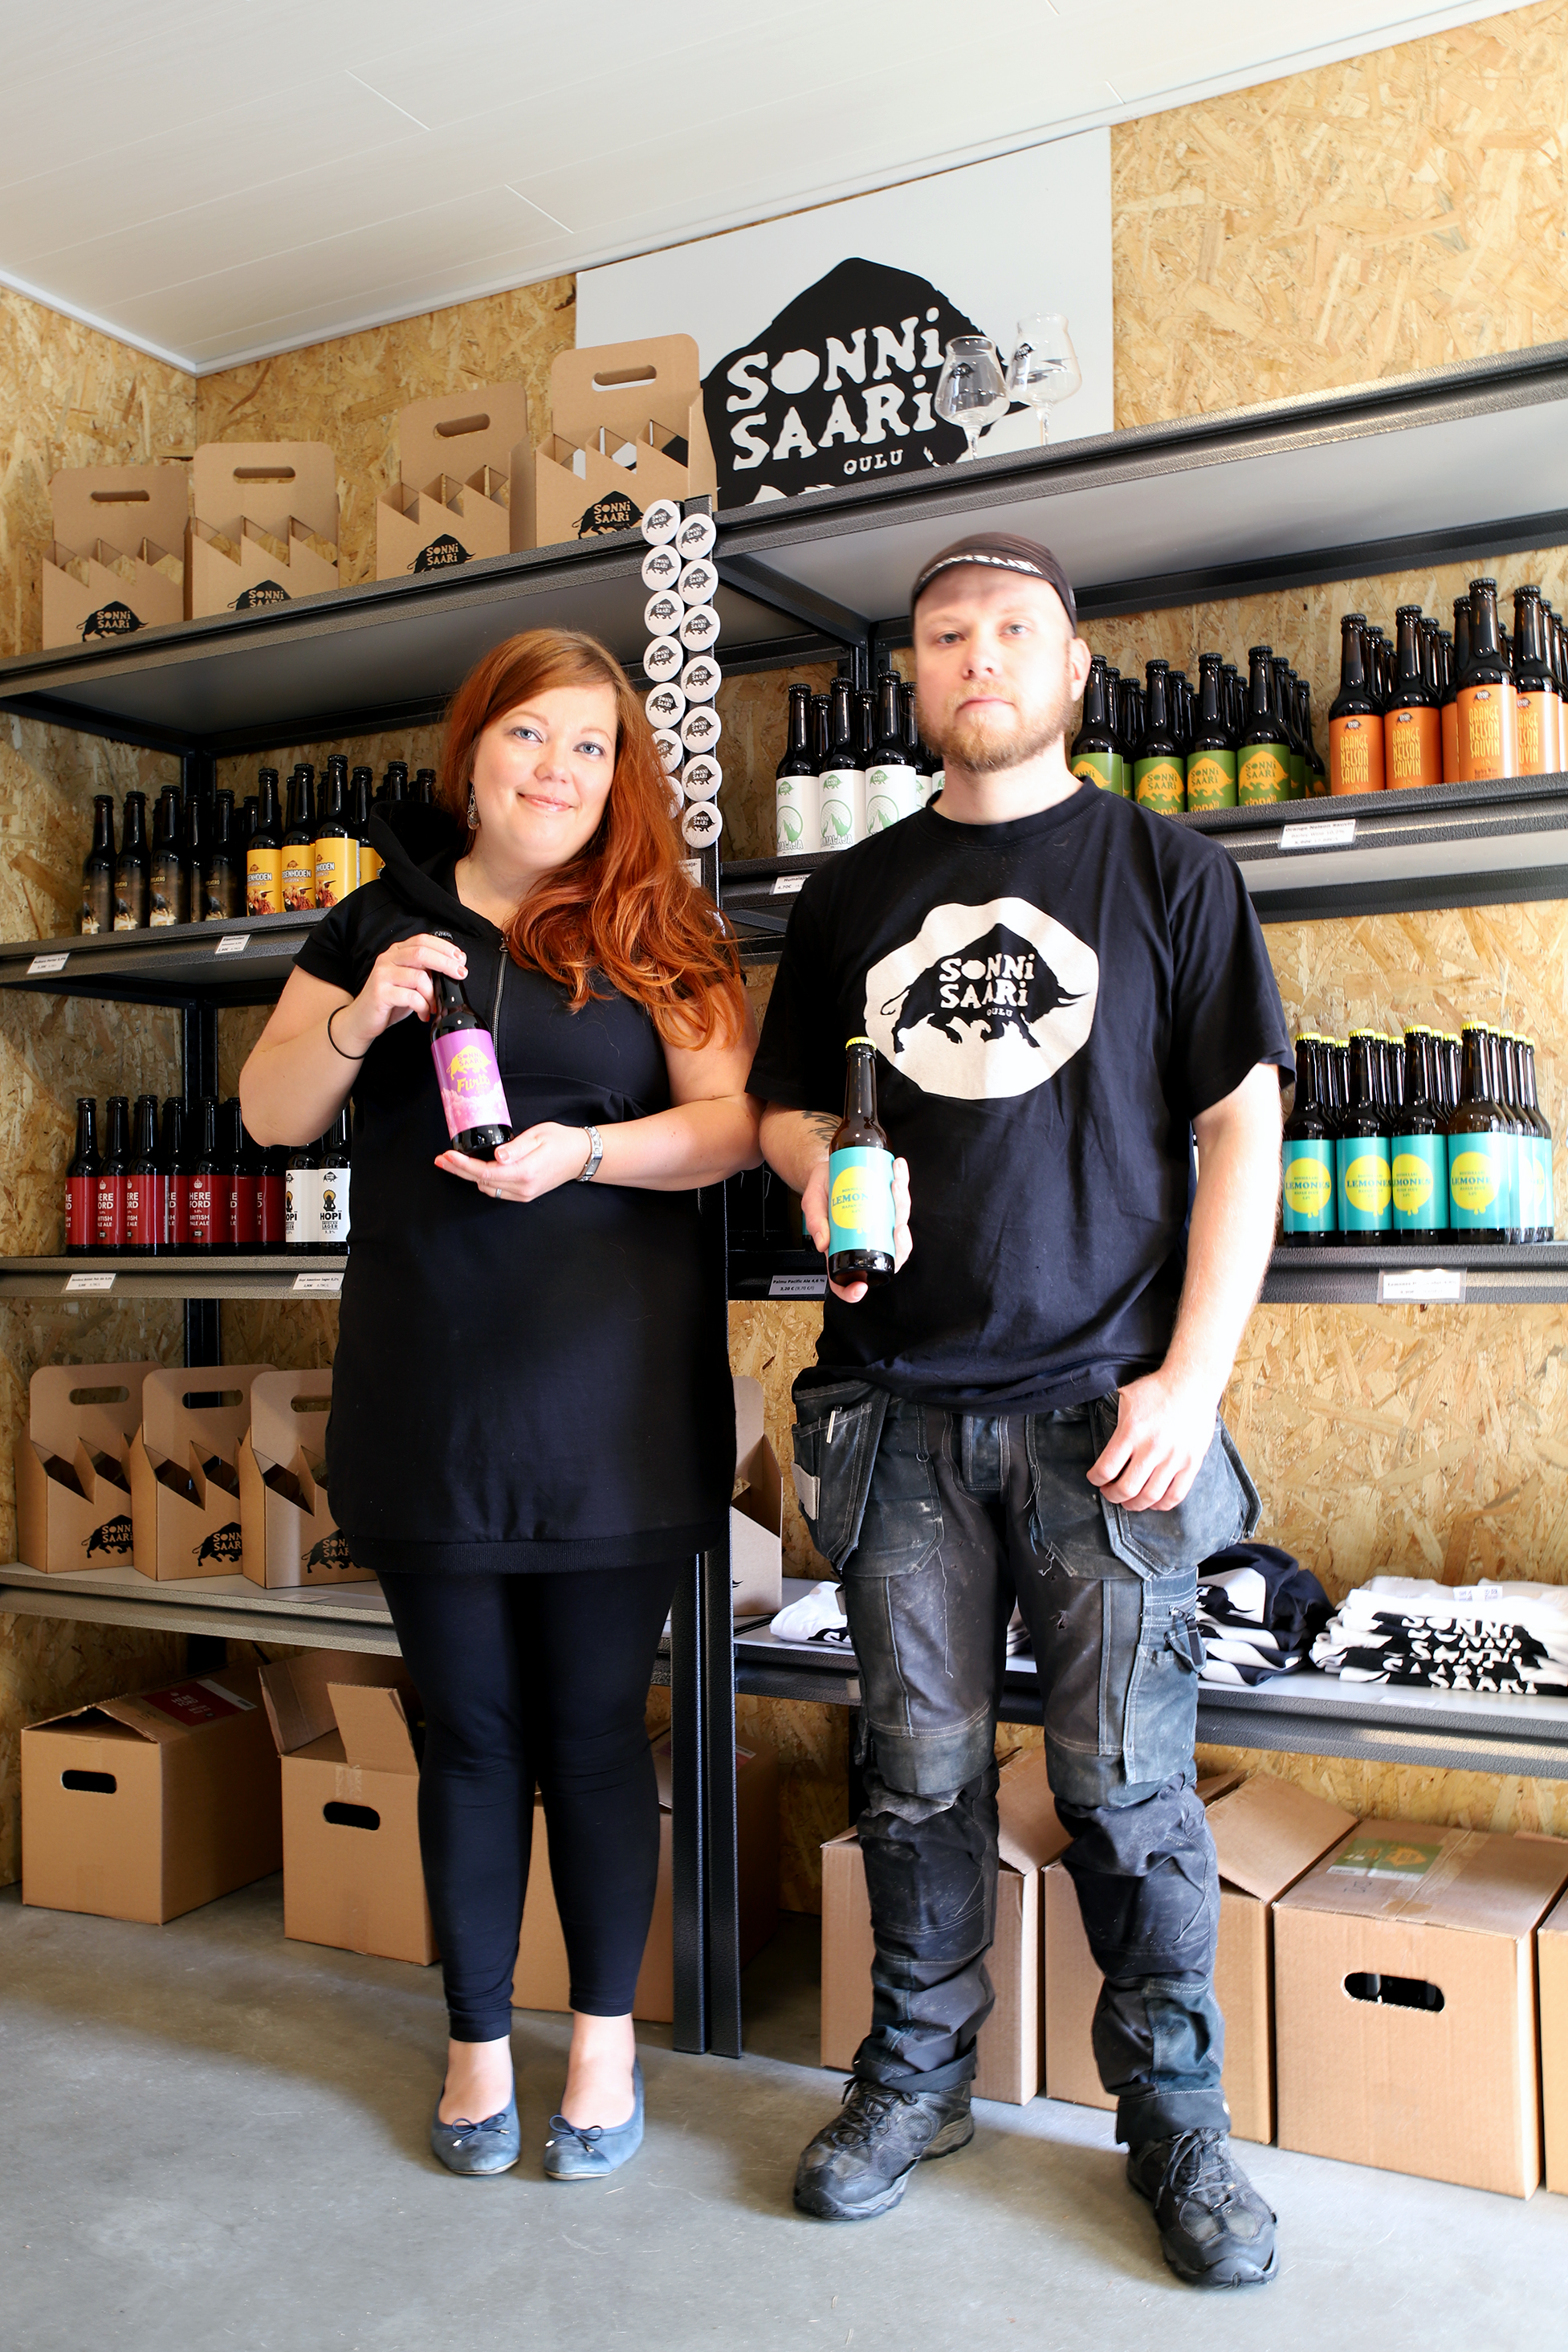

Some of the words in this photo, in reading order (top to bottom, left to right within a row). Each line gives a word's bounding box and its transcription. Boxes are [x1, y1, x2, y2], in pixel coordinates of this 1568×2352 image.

[843, 449, 904, 476] OULU
[1469, 705, 1499, 724] ORANGE
[1392, 727, 1420, 746] ORANGE
[1469, 719, 1500, 743] NELSON
[1340, 734, 1368, 752] ORANGE
[1393, 741, 1421, 762] NELSON
[1470, 739, 1500, 759] SAUVIN
[1341, 748, 1369, 768] NELSON
[1341, 765, 1369, 785] SAUVIN
[1394, 758, 1421, 779] SAUVIN
[1285, 1181, 1330, 1190] LEMONES
[189, 1192, 210, 1200] HERE
